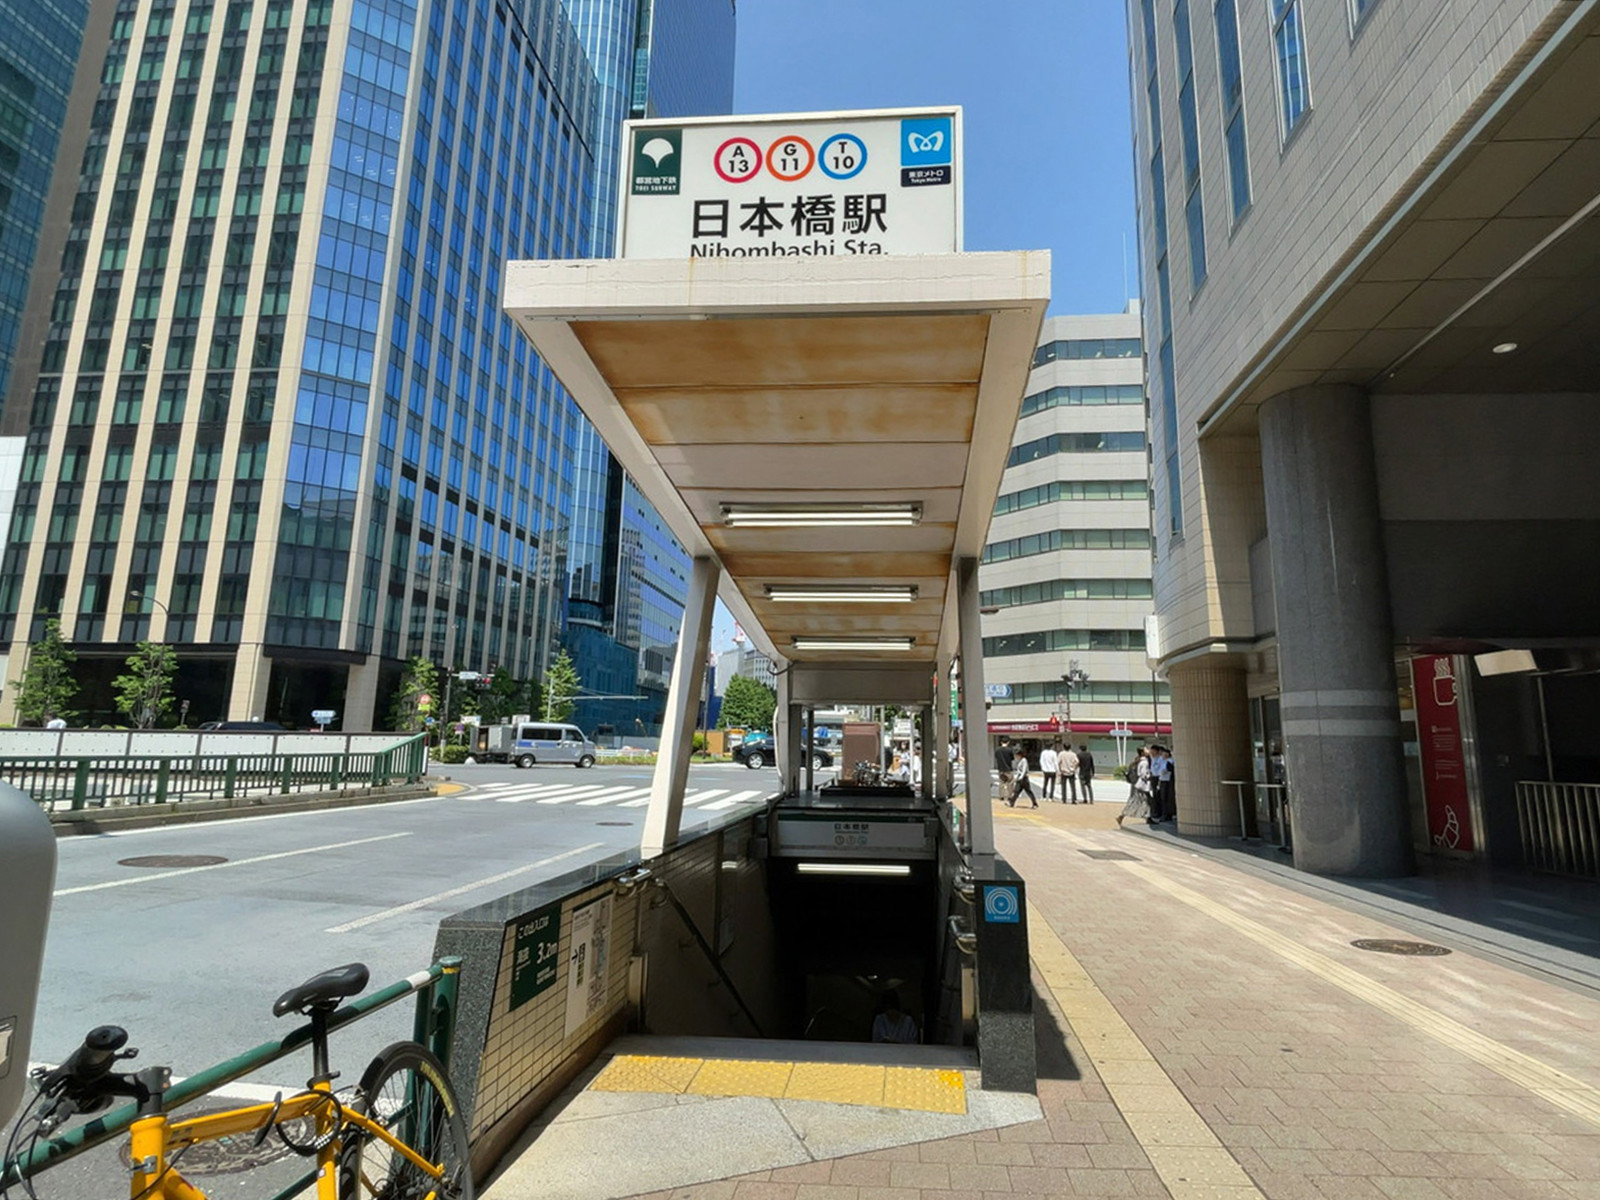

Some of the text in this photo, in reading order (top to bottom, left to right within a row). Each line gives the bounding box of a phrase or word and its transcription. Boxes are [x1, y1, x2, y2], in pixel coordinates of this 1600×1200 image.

[732, 145, 745, 157] A
[783, 143, 797, 156] G
[839, 141, 847, 154] T
[729, 159, 749, 173] 13
[781, 158, 799, 171] 11
[833, 156, 854, 169] 10
[692, 193, 888, 238] 日本橋駅
[691, 240, 834, 258] Nihombashi
